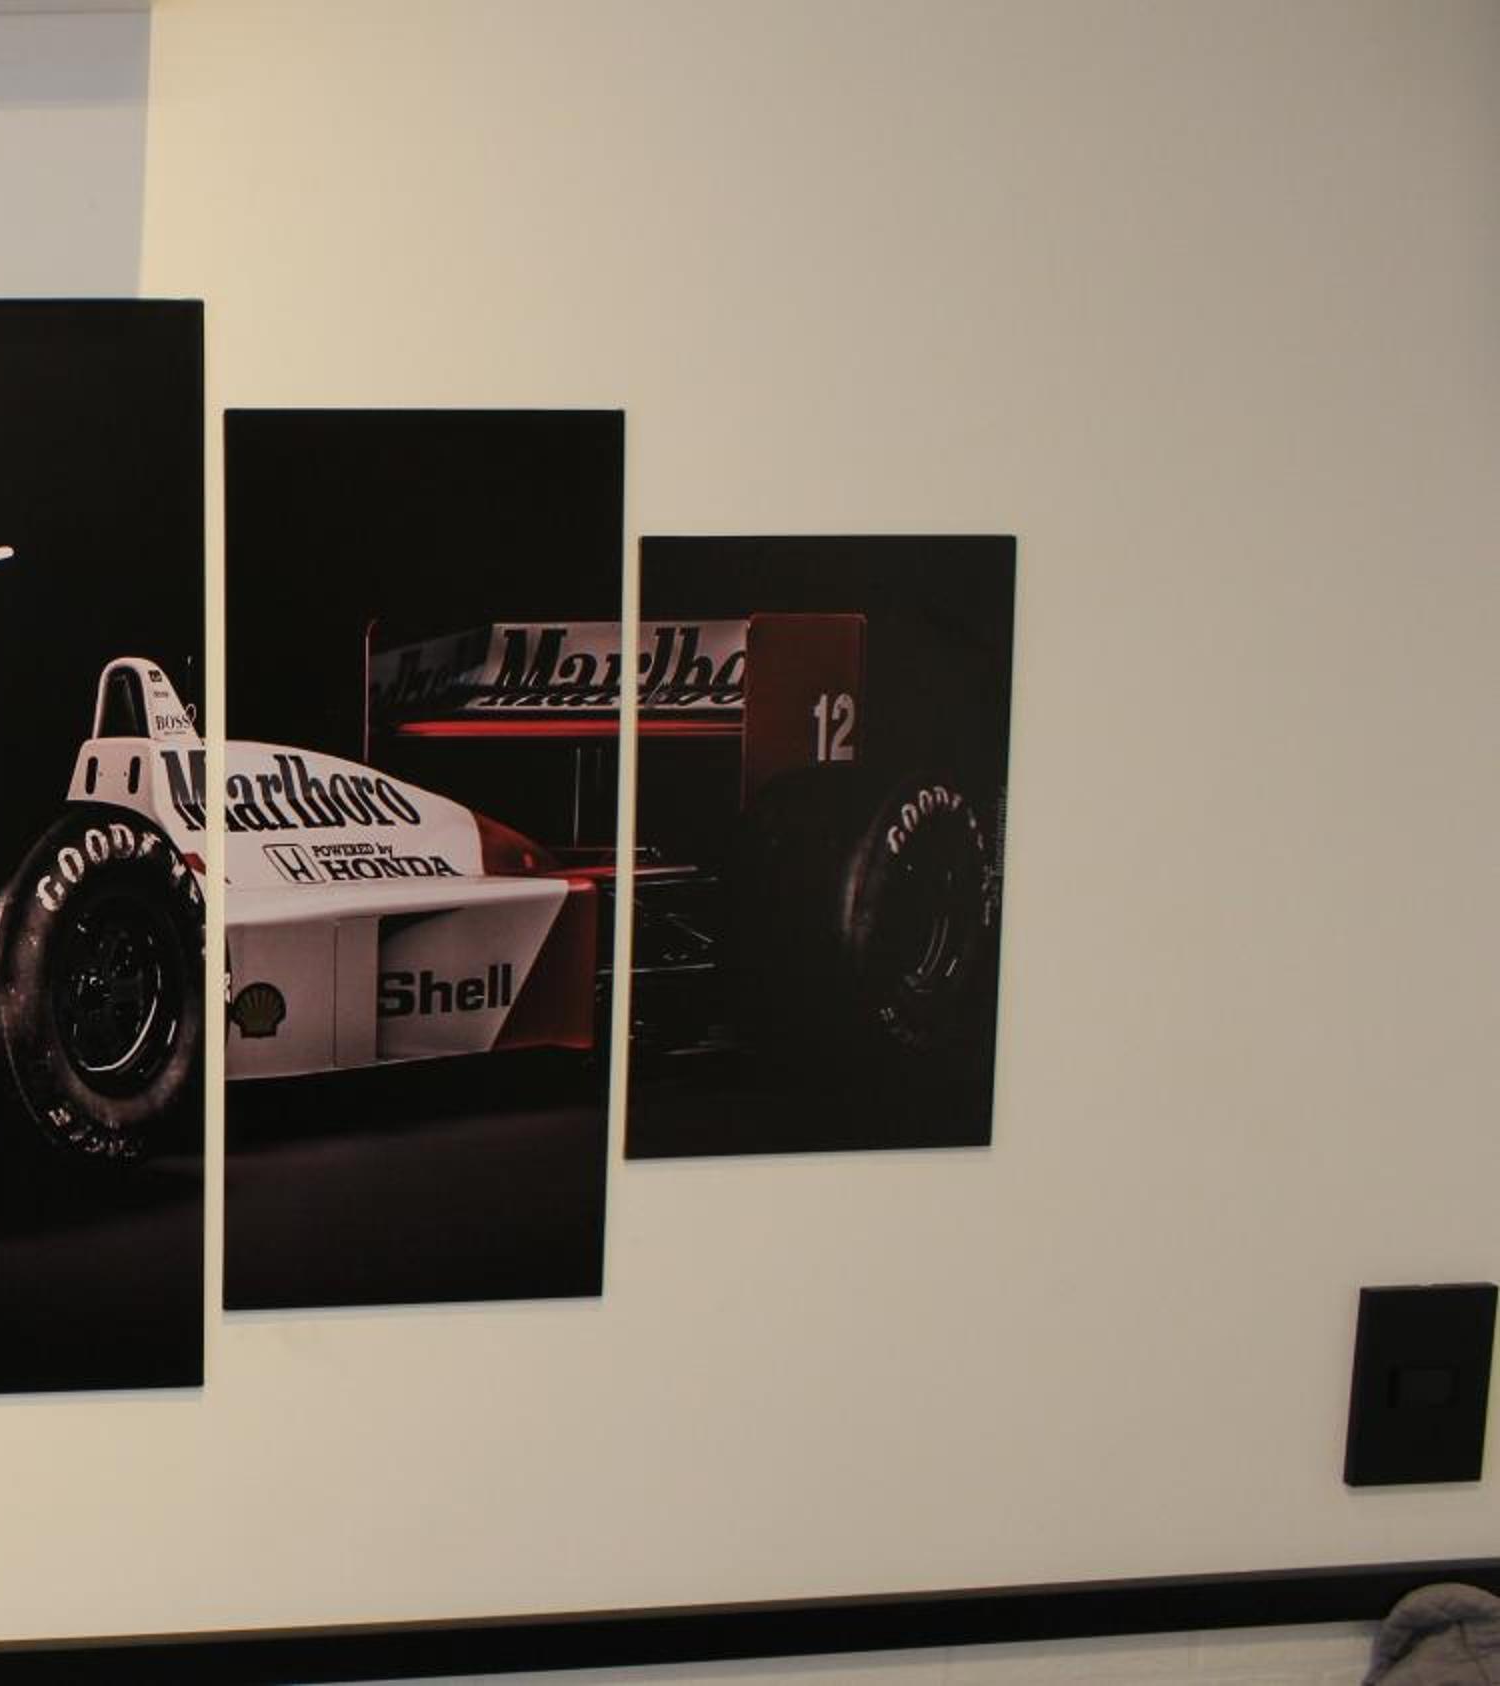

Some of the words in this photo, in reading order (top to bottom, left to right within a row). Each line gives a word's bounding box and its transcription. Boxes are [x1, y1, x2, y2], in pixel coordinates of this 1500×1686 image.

[492, 627, 747, 693] Marlbo
[813, 693, 856, 761] 12
[159, 750, 421, 833] Marlboro
[311, 843, 375, 859] POWERED
[376, 842, 394, 860] by
[318, 855, 465, 882] HONDA
[377, 963, 513, 1018] Shell
